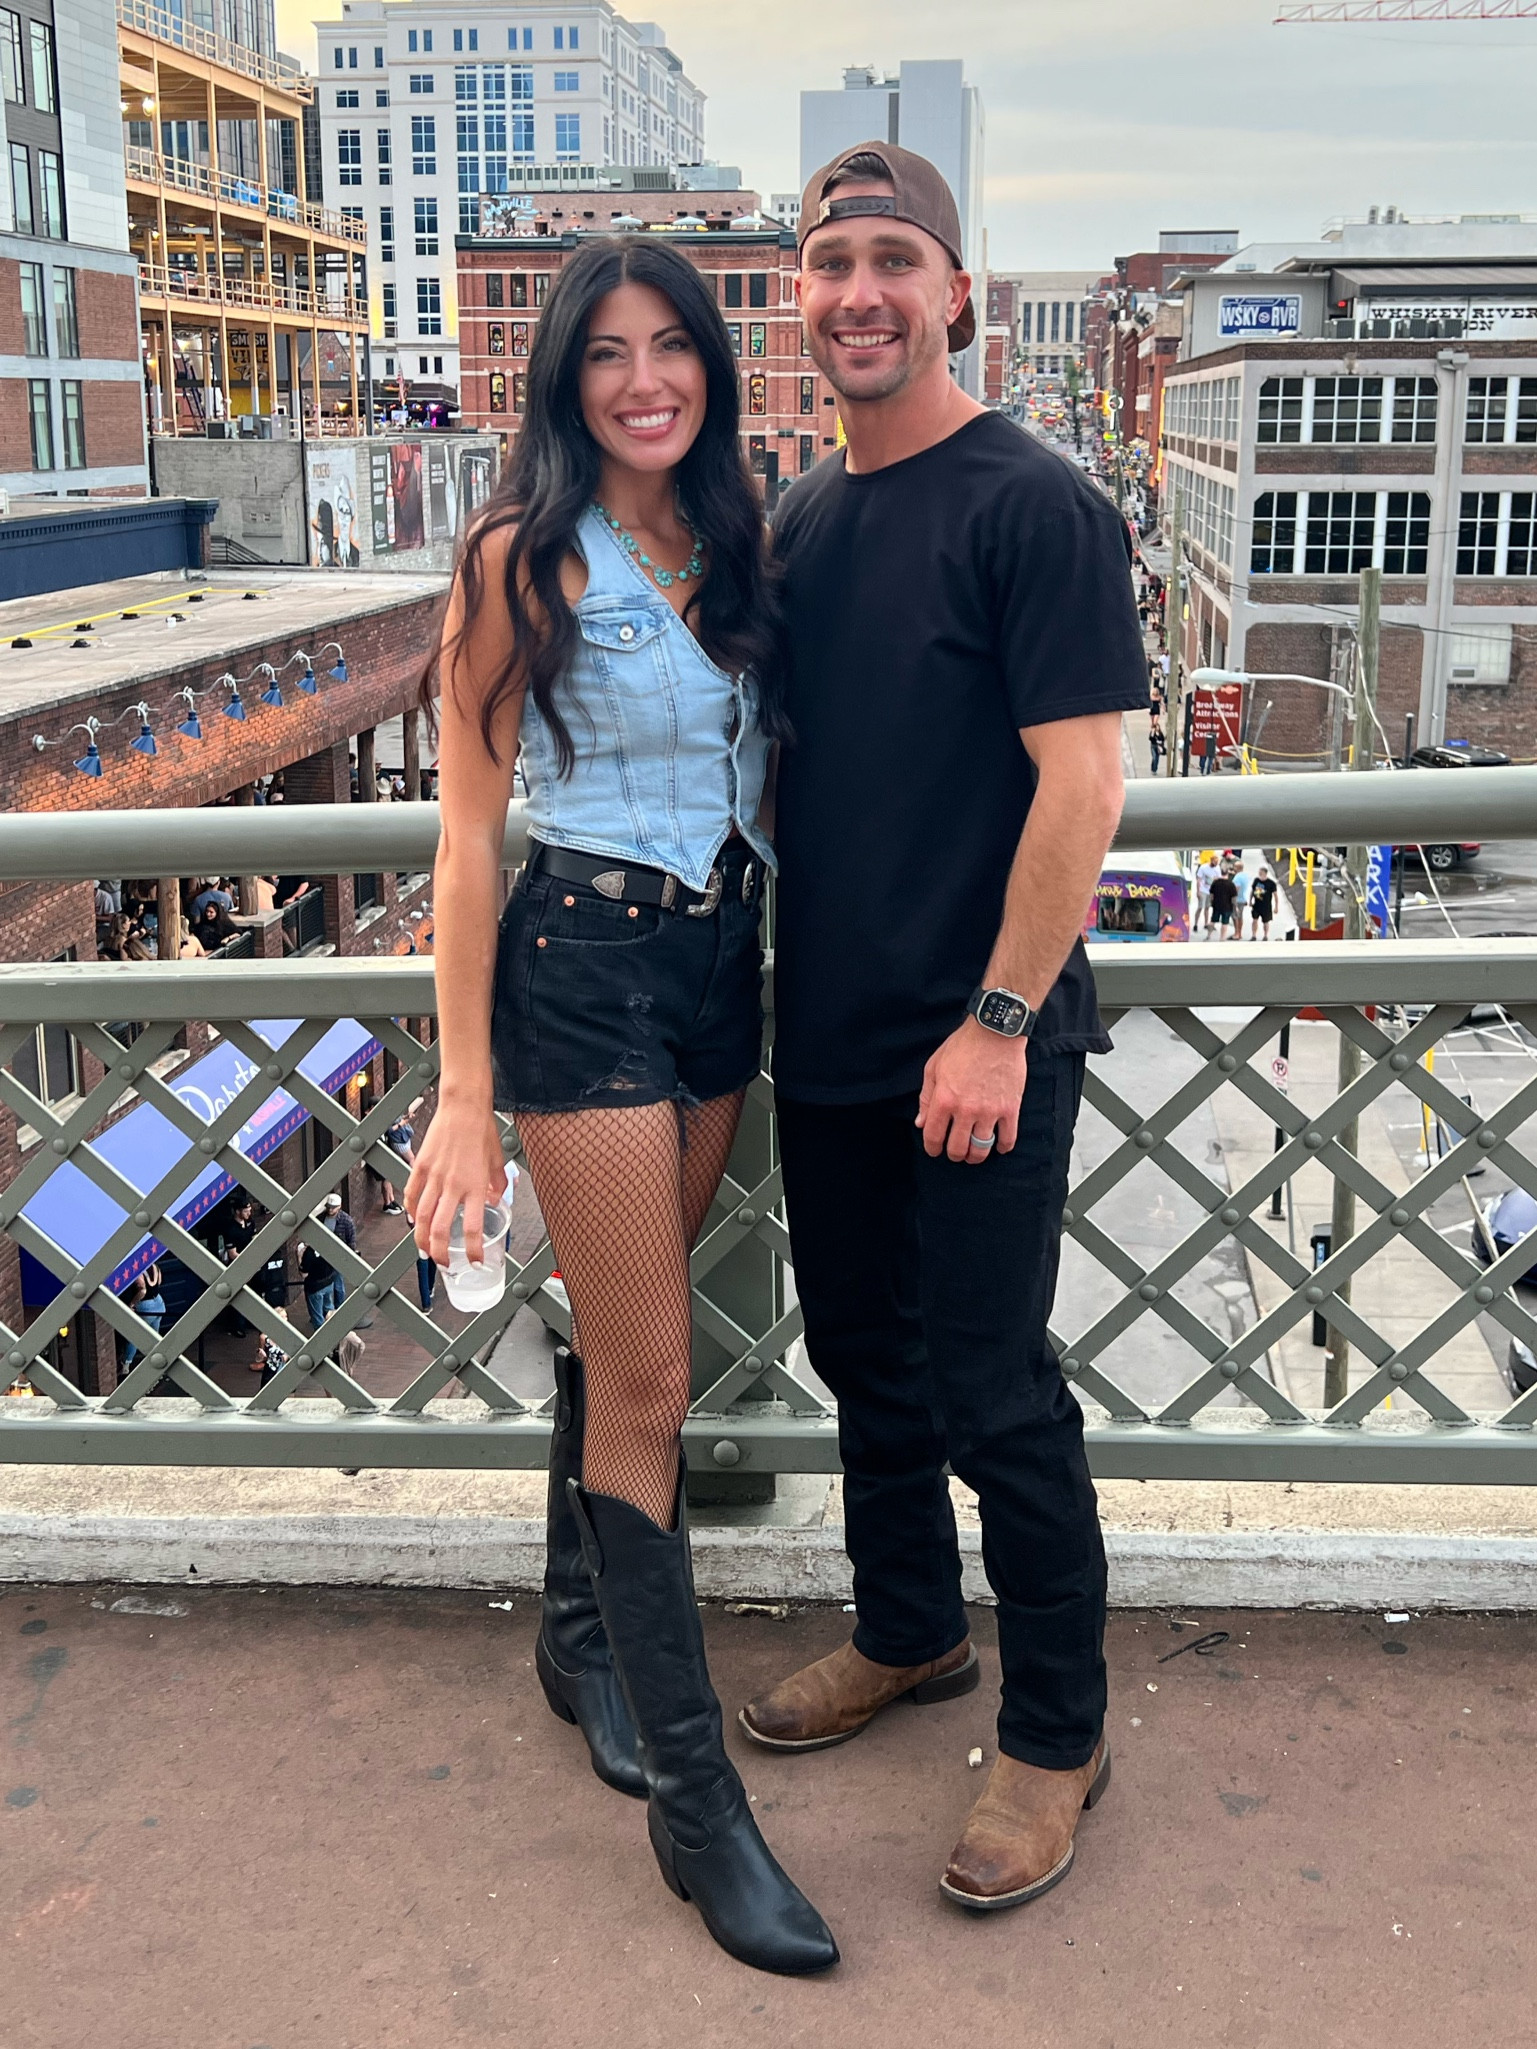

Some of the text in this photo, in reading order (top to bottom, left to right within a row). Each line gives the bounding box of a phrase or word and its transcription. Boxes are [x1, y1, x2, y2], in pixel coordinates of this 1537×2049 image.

[1222, 306, 1297, 327] WSKY RVR
[1371, 307, 1537, 319] WHISKEY RIVER
[1196, 701, 1235, 710] Broaway
[1366, 845, 1383, 905] ARK
